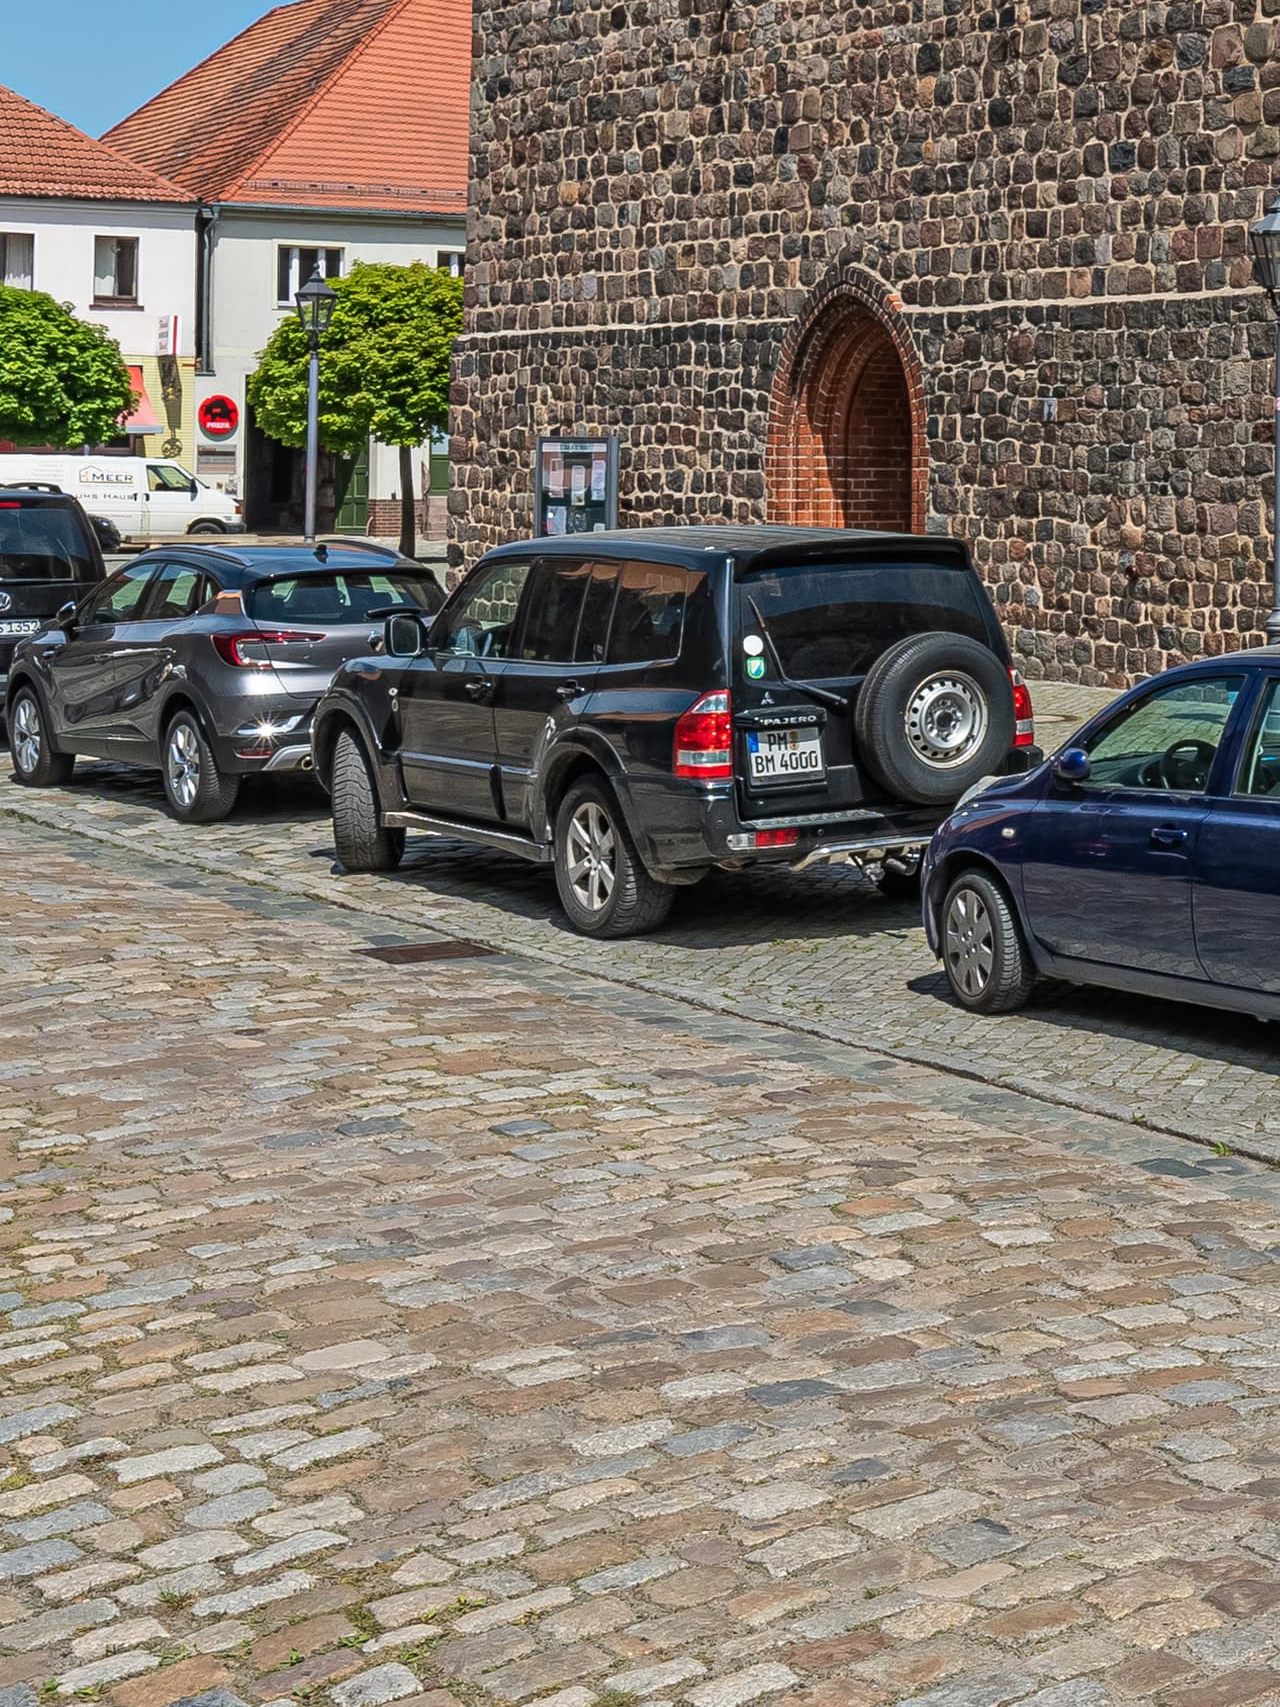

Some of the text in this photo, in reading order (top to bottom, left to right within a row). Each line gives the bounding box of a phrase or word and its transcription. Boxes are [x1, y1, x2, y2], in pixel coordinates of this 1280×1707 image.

[763, 714, 817, 726] PAJERO
[768, 732, 788, 752] PM
[755, 751, 818, 774] BM 4000
